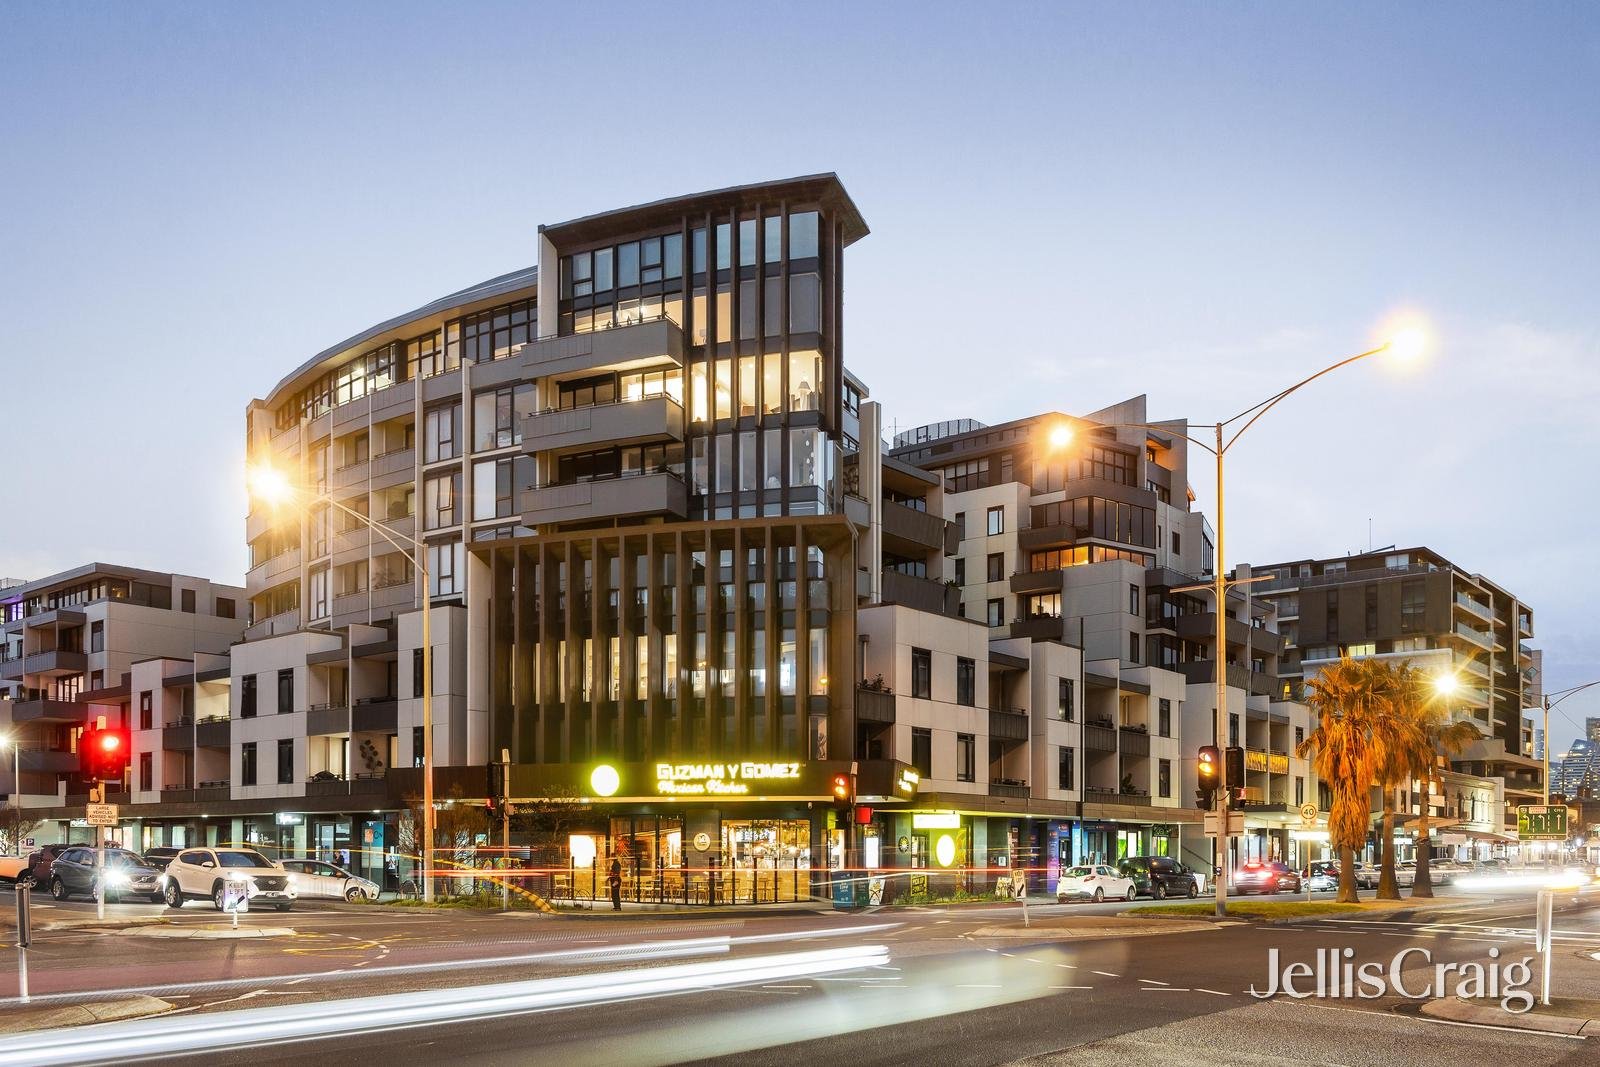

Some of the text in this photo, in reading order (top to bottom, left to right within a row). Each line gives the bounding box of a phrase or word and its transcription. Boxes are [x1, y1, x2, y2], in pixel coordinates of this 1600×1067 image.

[657, 762, 800, 780] GUZMAN Y GOMEZ
